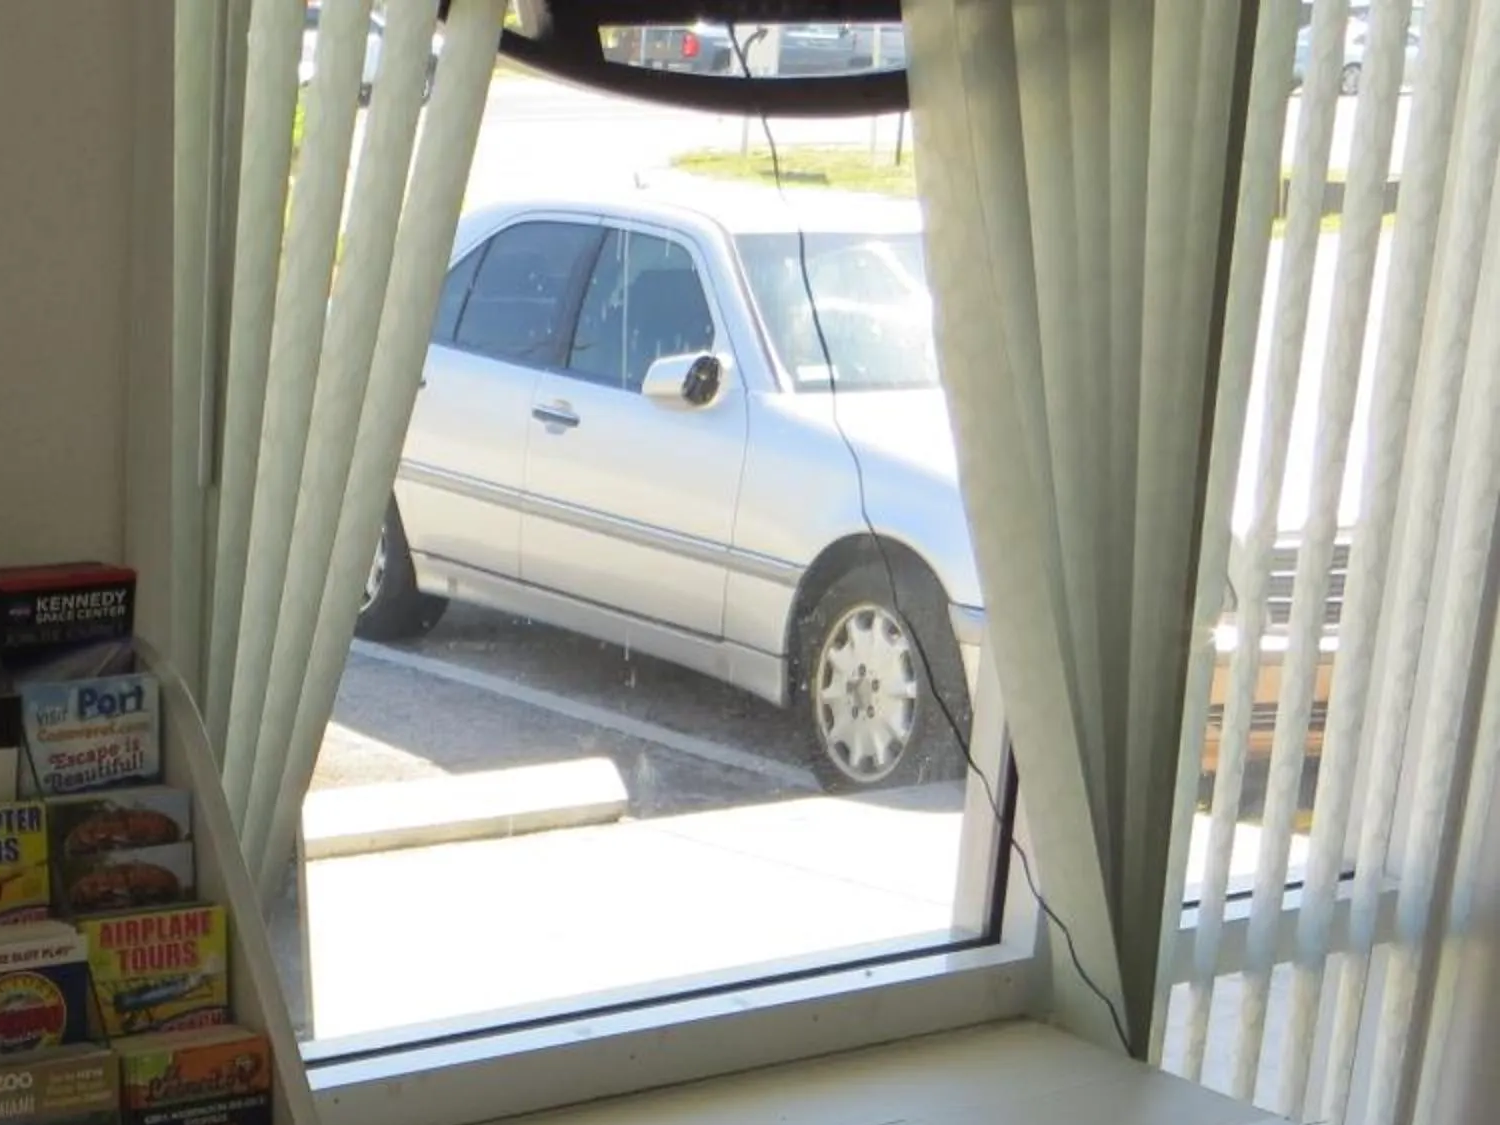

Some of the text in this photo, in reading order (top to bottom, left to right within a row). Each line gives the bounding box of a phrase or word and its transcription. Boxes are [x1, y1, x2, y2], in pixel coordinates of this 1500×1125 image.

[36, 590, 127, 613] KENNEDY
[36, 609, 74, 624] SPACE
[76, 604, 126, 619] CENTER
[78, 683, 146, 720] Port
[48, 743, 121, 770] Escape
[99, 909, 213, 949] AIRPLANE
[116, 940, 199, 976] TOURS
